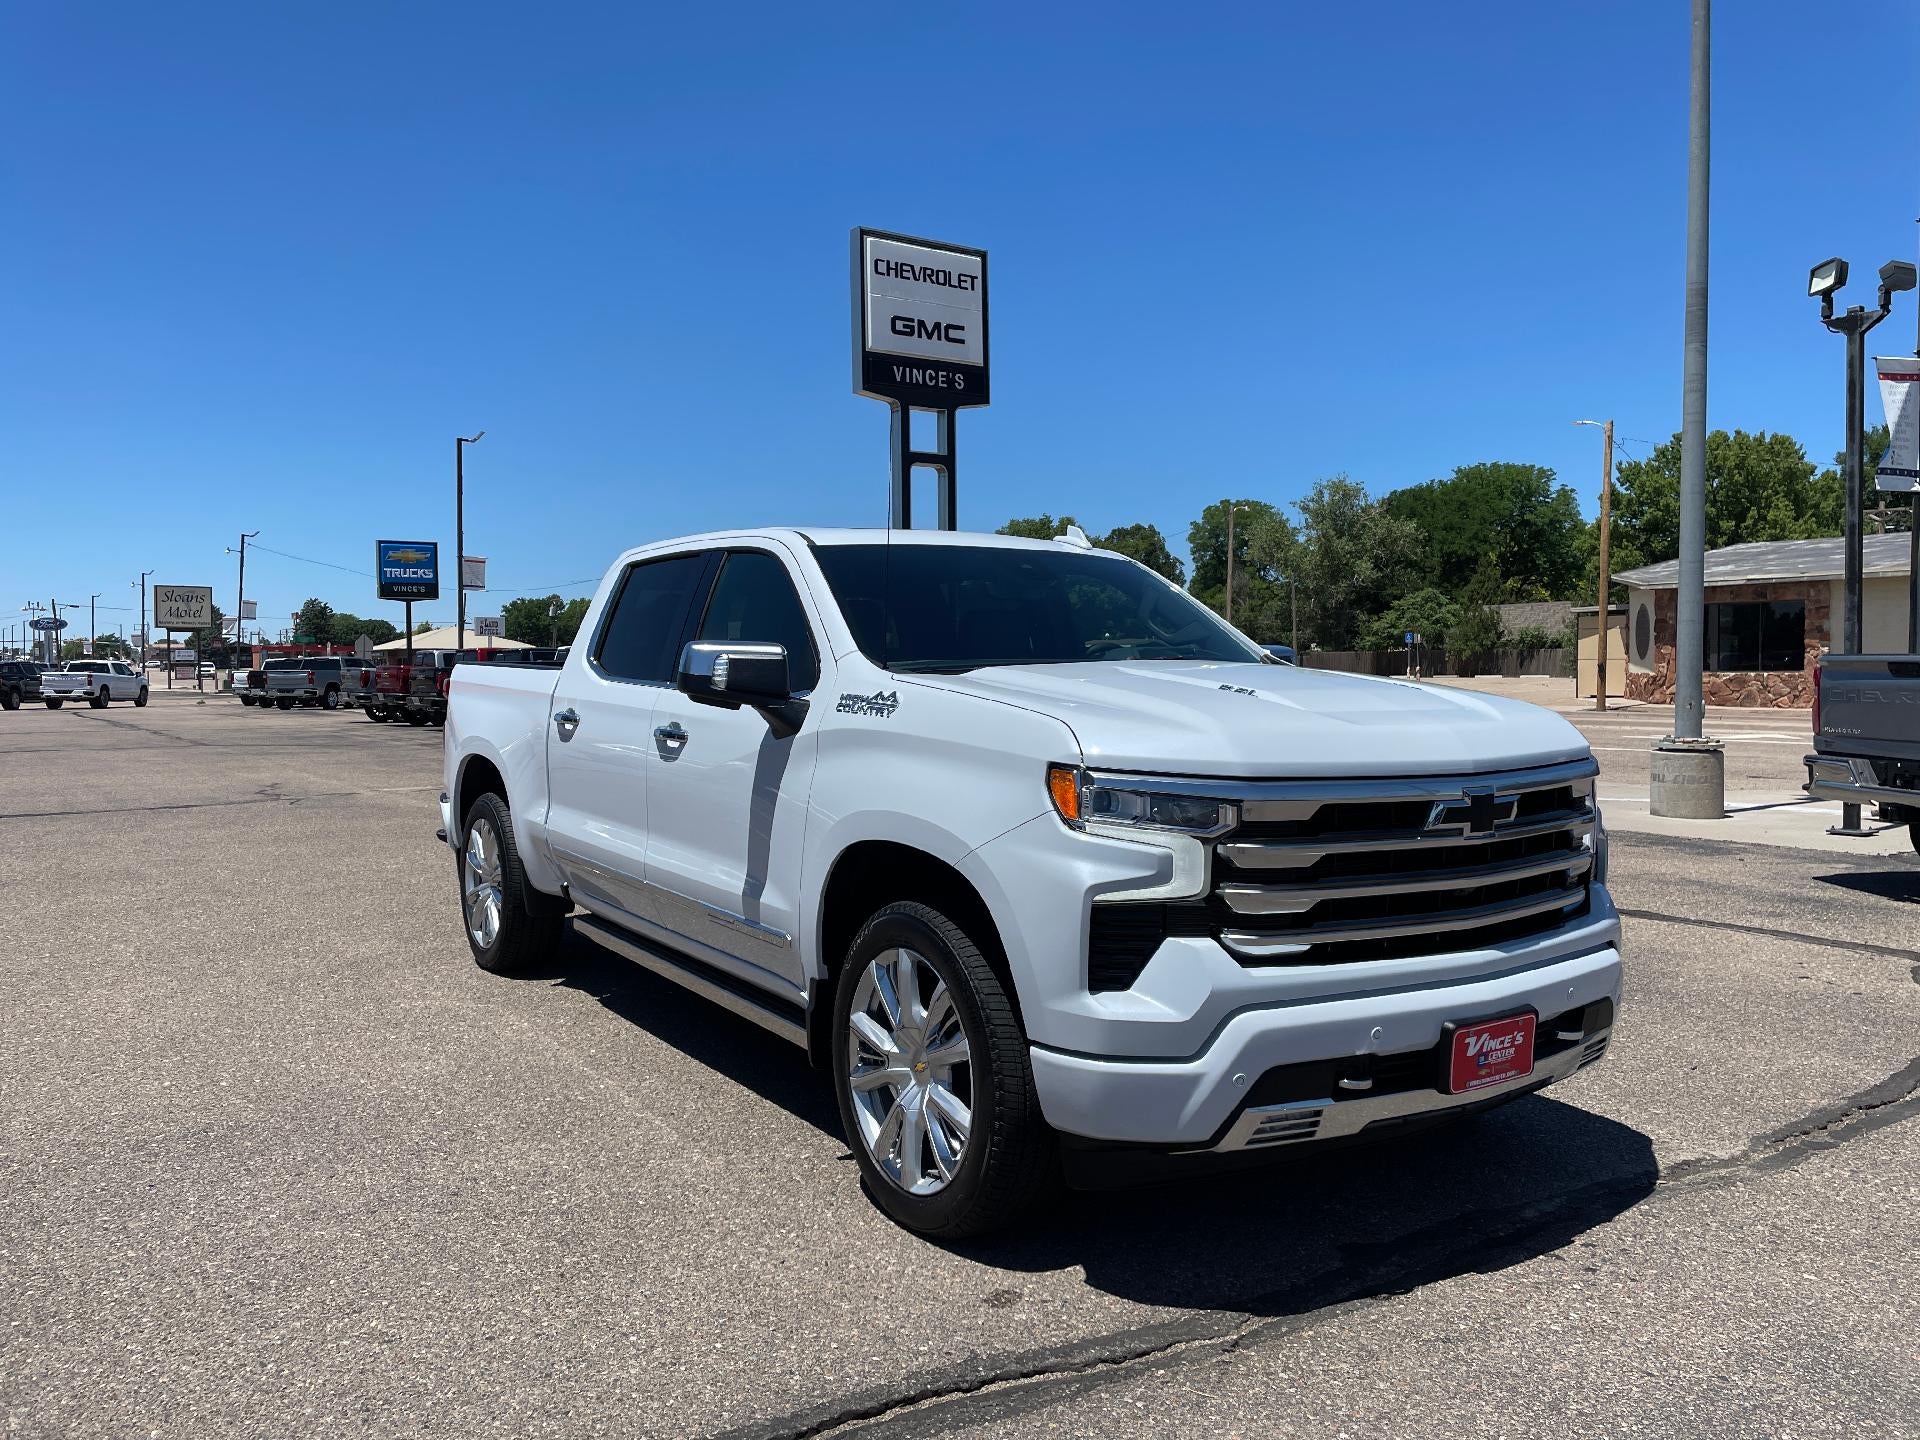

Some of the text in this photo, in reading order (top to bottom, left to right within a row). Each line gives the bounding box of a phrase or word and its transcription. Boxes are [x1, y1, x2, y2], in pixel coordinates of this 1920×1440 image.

[873, 257, 979, 291] CHEVROLET
[890, 314, 966, 345] GMC
[893, 365, 965, 390] VINCE'S
[383, 567, 434, 579] TRUCKS
[161, 589, 206, 604] Sloans
[392, 585, 426, 593] VINCE'S
[164, 605, 204, 618] Motel
[1828, 687, 1920, 704] CHEVR
[1488, 1047, 1516, 1061] CENTER
